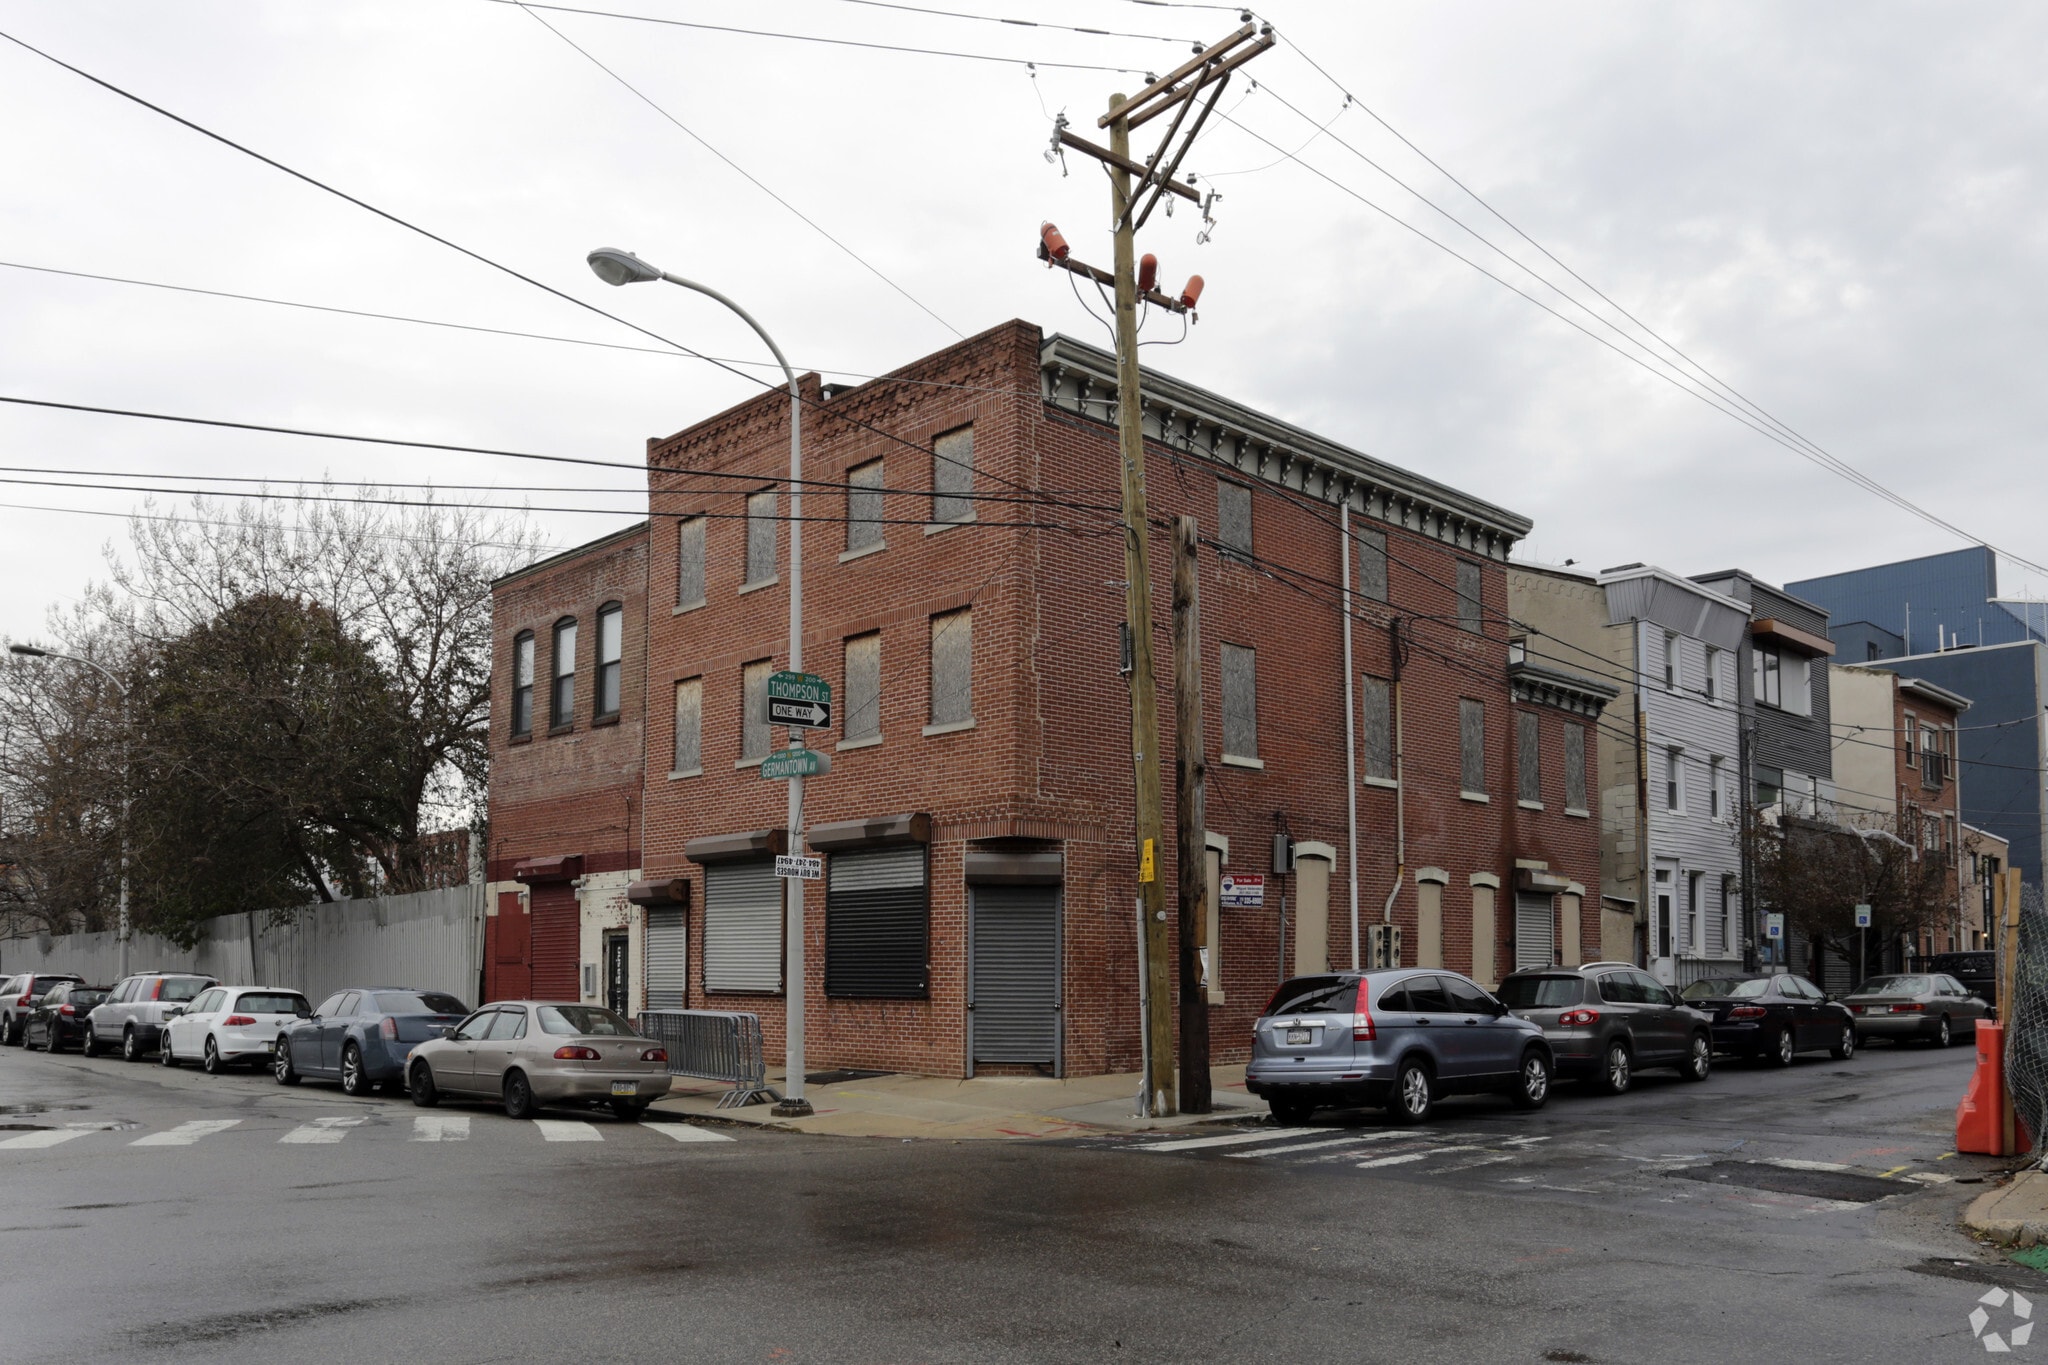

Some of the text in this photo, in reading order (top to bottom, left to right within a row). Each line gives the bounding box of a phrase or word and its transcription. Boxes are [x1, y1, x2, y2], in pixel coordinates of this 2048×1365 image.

[771, 681, 828, 701] THOMPSON ST
[776, 705, 812, 718] ONE WAY
[763, 758, 808, 777] GERMANTOWN
[777, 867, 819, 878] WE BUY HOUSES
